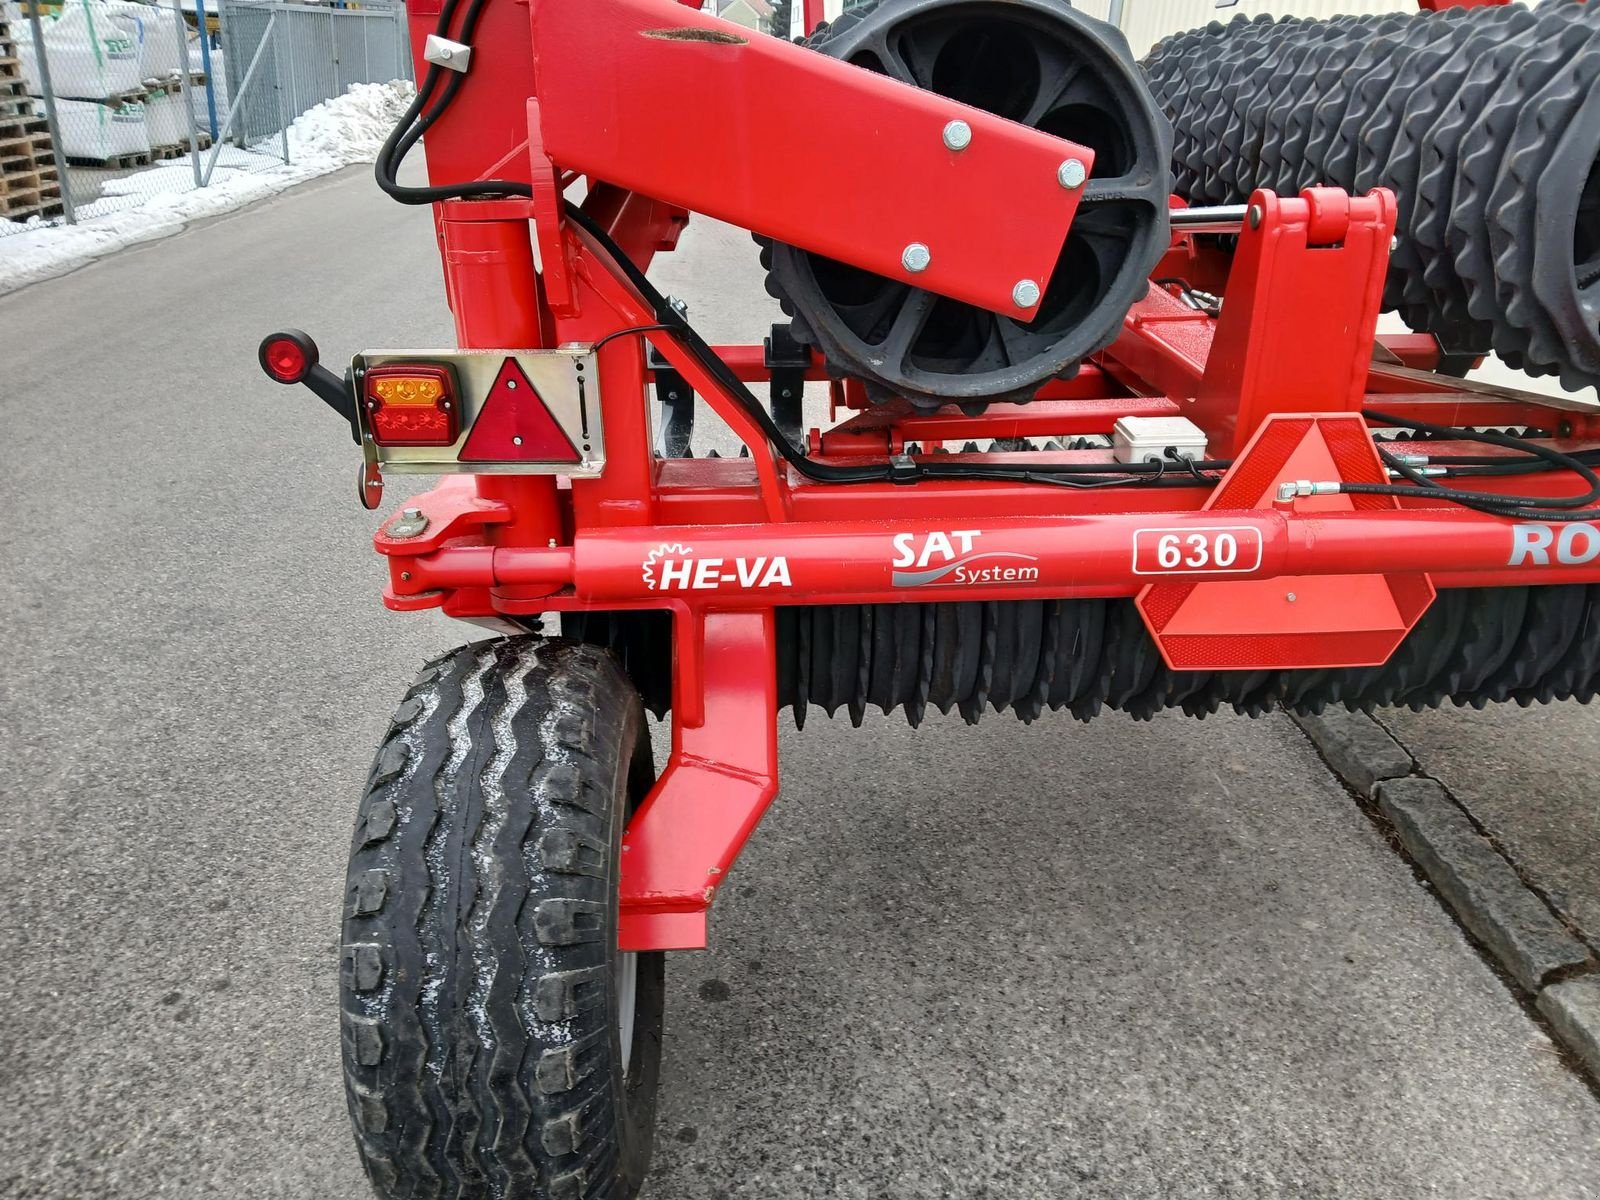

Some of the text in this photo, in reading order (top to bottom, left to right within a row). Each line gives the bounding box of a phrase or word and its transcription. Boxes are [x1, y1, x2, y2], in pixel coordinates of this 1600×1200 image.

[893, 530, 982, 567] SAT
[1157, 533, 1238, 567] 630
[660, 556, 792, 589] HE-VA
[954, 565, 1040, 585] System
